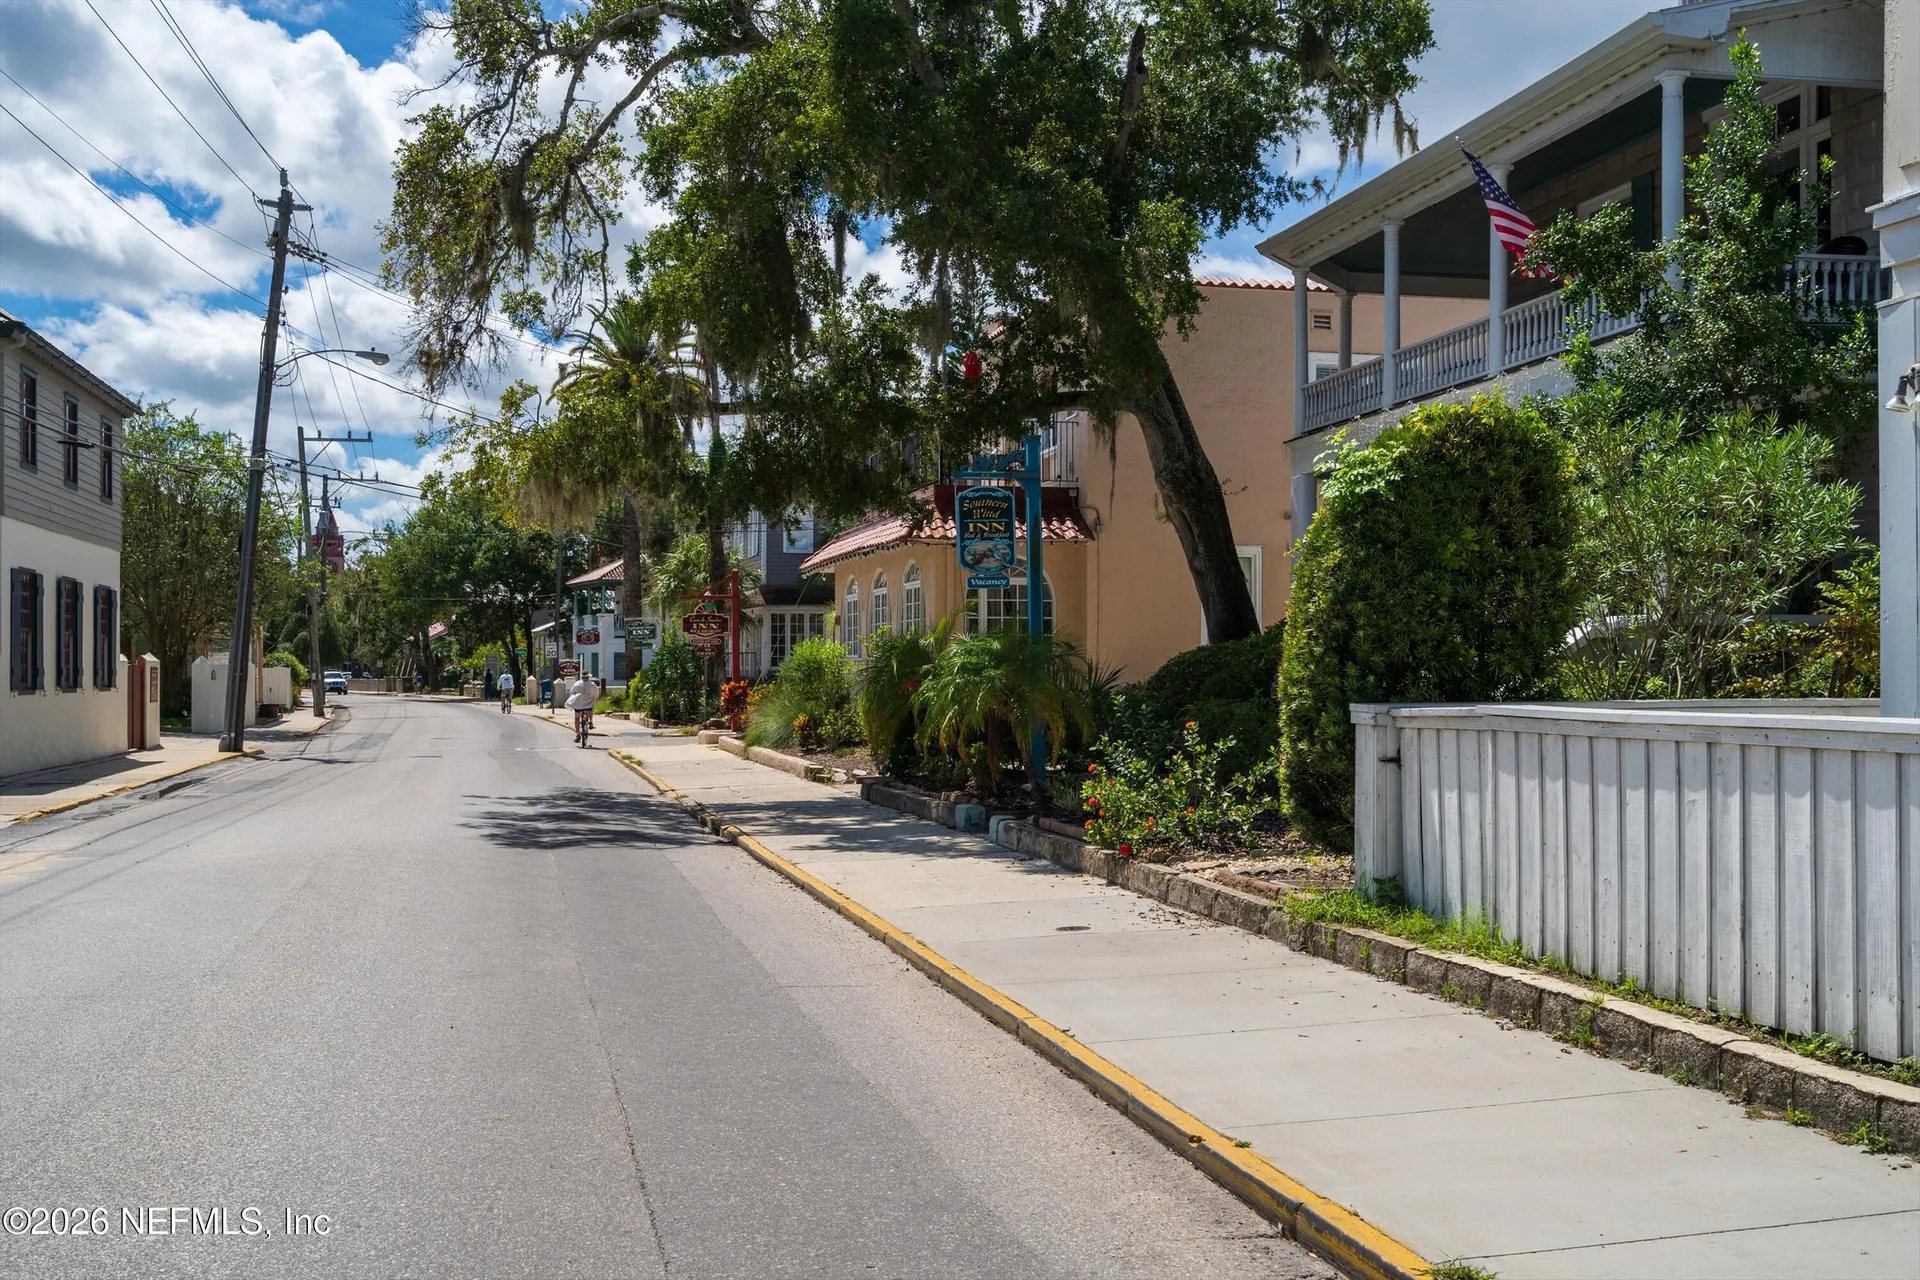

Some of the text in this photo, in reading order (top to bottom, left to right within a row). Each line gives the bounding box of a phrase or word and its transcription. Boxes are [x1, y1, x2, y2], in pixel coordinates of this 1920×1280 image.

[963, 498, 1009, 511] Southern
[973, 508, 1002, 519] Wind
[967, 522, 1006, 533] INN
[971, 578, 1008, 588] Vacancy
